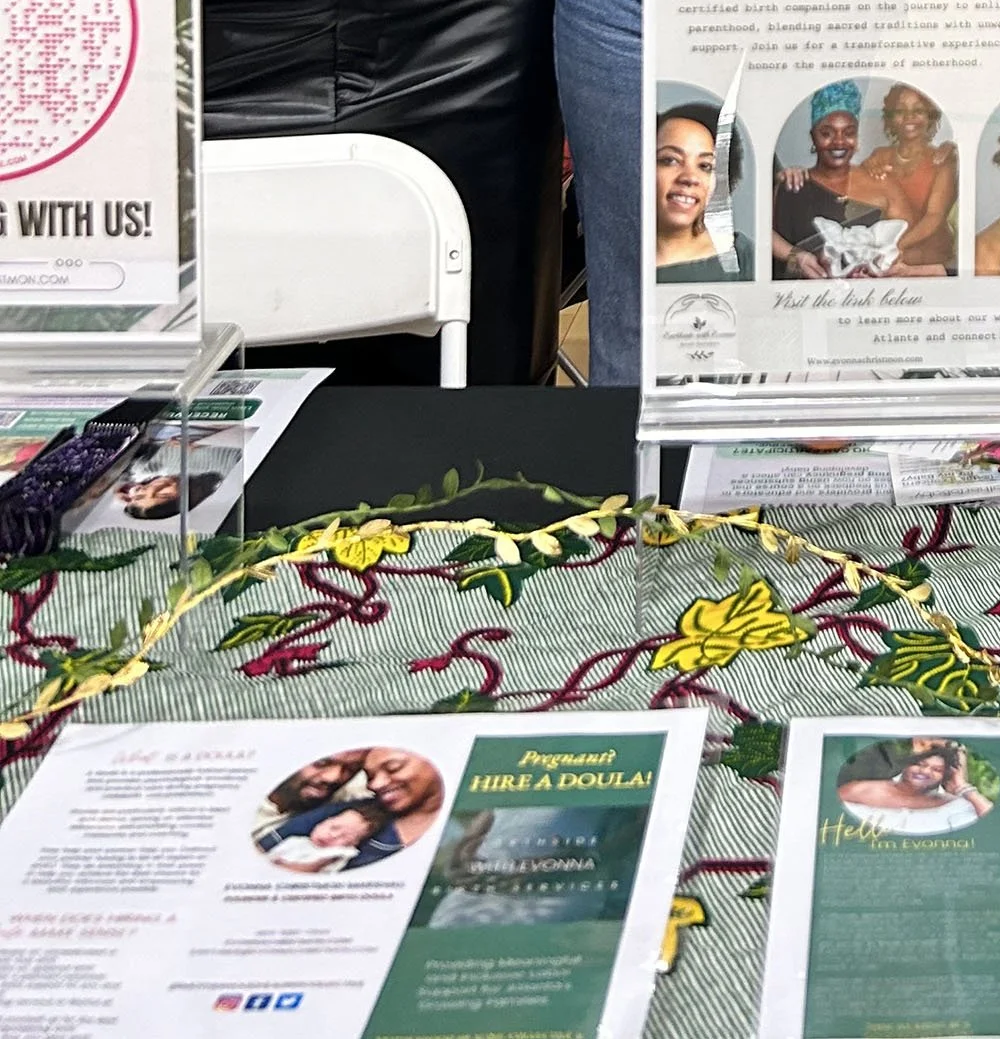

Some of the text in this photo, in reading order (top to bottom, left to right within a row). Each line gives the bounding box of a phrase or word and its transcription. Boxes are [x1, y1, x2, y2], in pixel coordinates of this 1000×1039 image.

[677, 4, 740, 14] certified
[744, 4, 779, 14] birth
[783, 4, 851, 14] companions
[855, 3, 872, 12] on
[876, 2, 897, 12] the
[903, 3, 949, 14] journey
[687, 24, 760, 34] parenthood,
[766, 22, 822, 33] blending
[825, 22, 868, 31] sacred
[872, 21, 939, 30] traditions
[944, 20, 972, 29] with
[18, 200, 94, 237] WITH
[104, 200, 153, 237] US!
[872, 333, 920, 344] Atlanta
[925, 332, 946, 343] and
[517, 748, 617, 770] Pregnant?
[469, 770, 653, 792] HIRE A DOULA!
